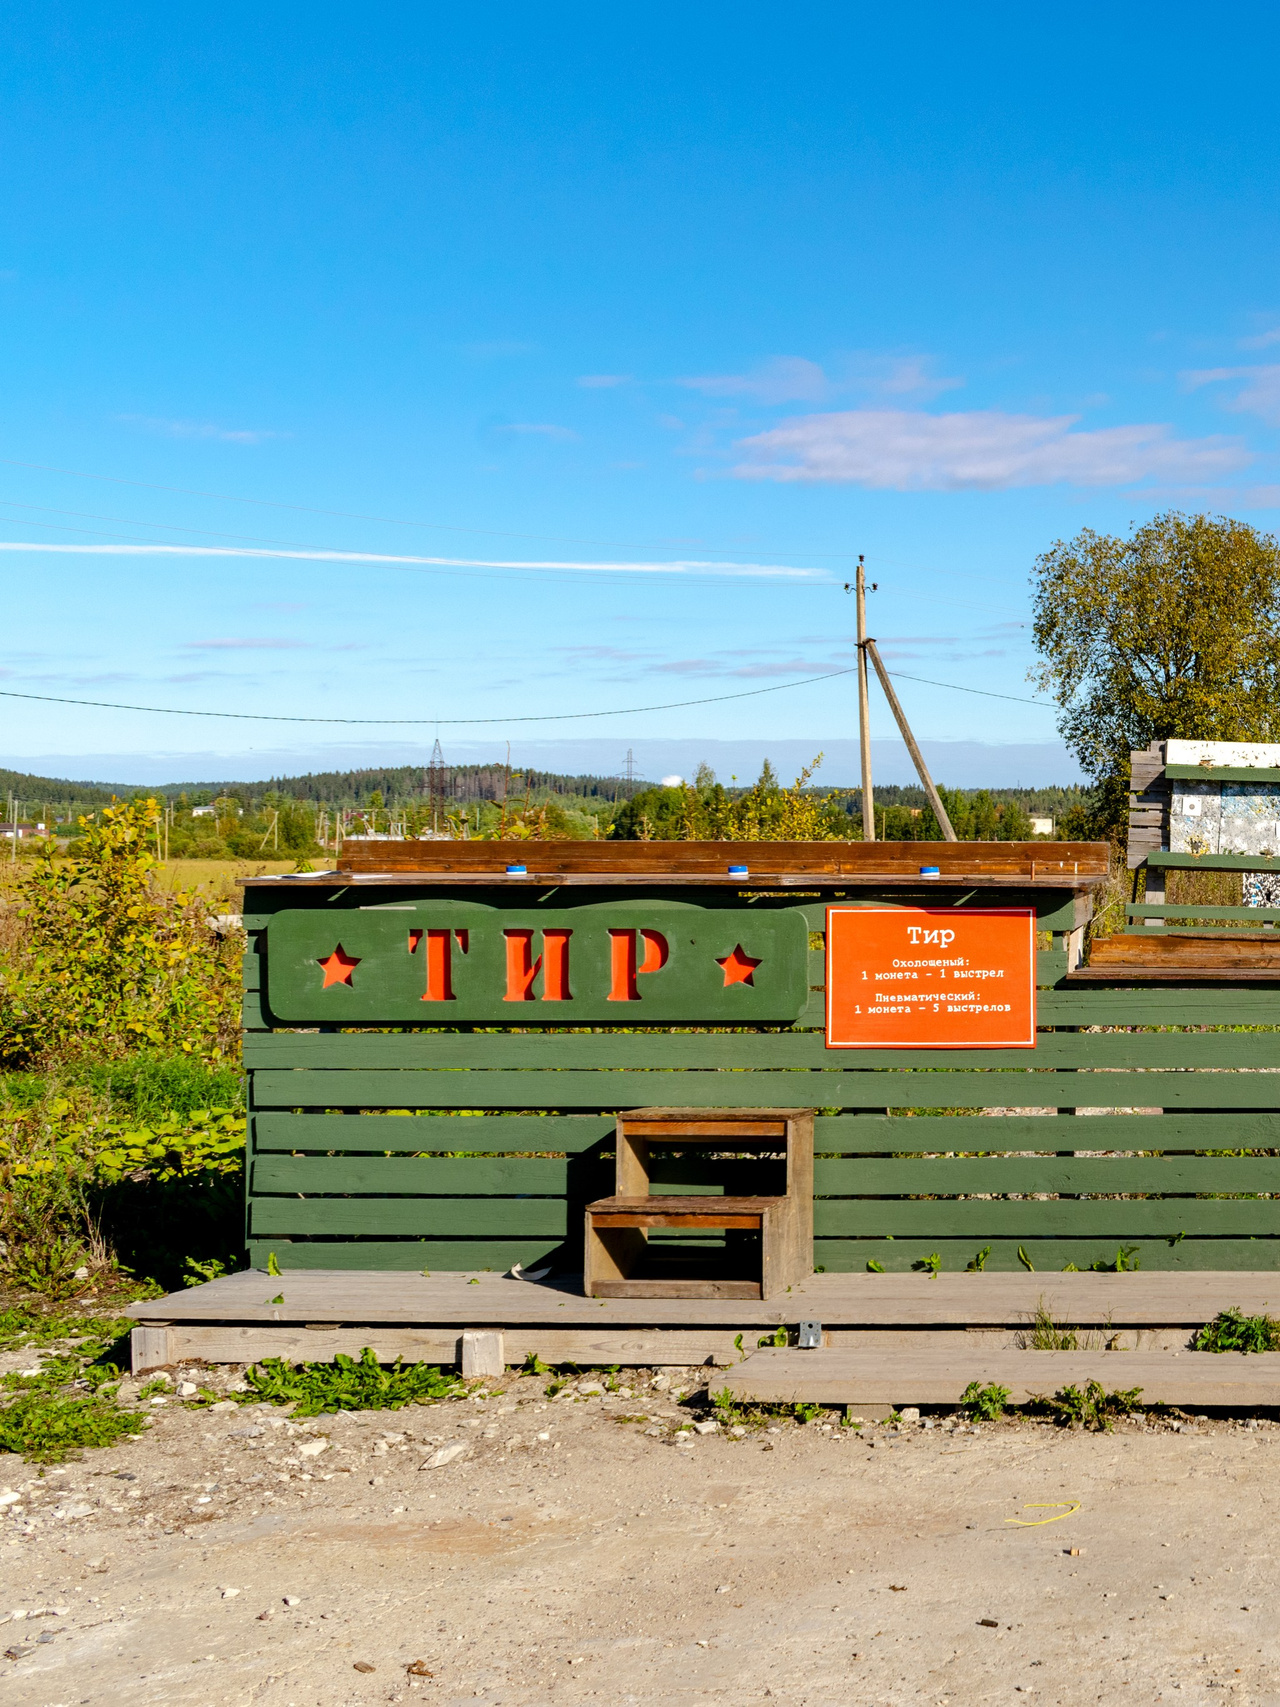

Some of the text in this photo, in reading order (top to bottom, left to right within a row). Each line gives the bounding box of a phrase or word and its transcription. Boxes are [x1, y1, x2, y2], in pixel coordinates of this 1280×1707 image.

[907, 926, 956, 949] Тир
[408, 927, 670, 1002] ТИР
[892, 957, 970, 968] Охолощеный:
[861, 970, 869, 980] 1
[875, 971, 919, 980] монета
[940, 969, 946, 979] 1
[953, 969, 1004, 979] выстрел
[875, 991, 981, 1003] Пневматический:
[854, 1005, 862, 1014] 1
[867, 1004, 912, 1014] монета
[933, 1003, 940, 1013] 5
[946, 1003, 1012, 1014] выстрелов
